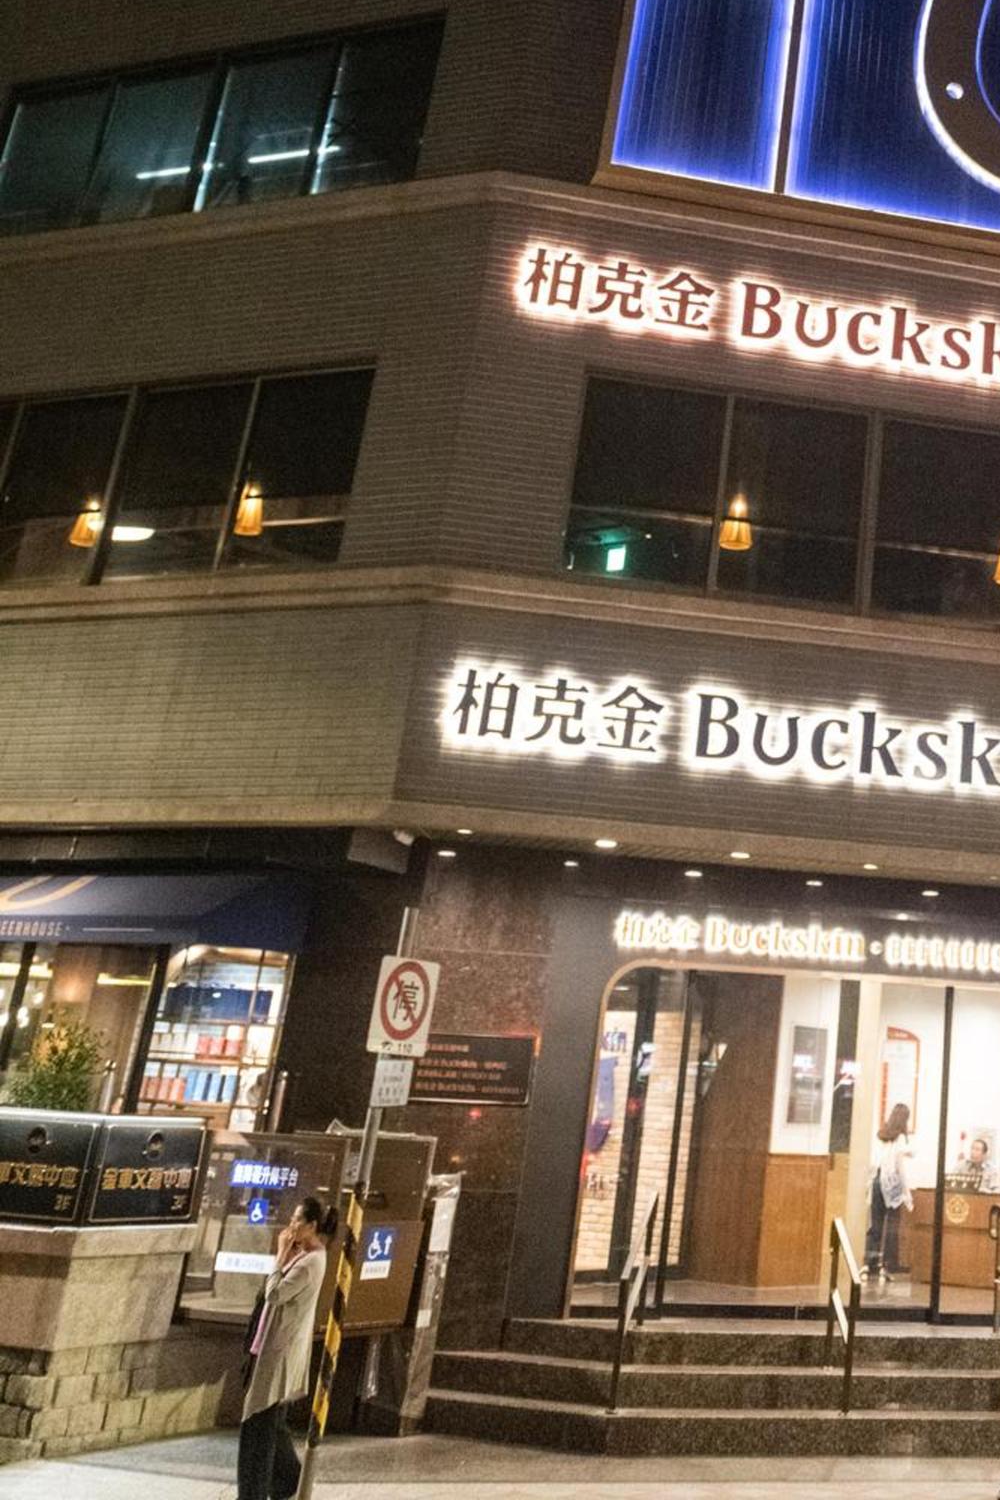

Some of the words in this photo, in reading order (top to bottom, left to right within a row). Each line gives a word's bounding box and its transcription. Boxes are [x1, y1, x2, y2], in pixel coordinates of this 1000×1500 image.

[524, 246, 712, 332] 柏克金
[454, 668, 666, 754] 柏克金
[704, 915, 866, 962] Buckskin
[392, 980, 420, 1022] 停
